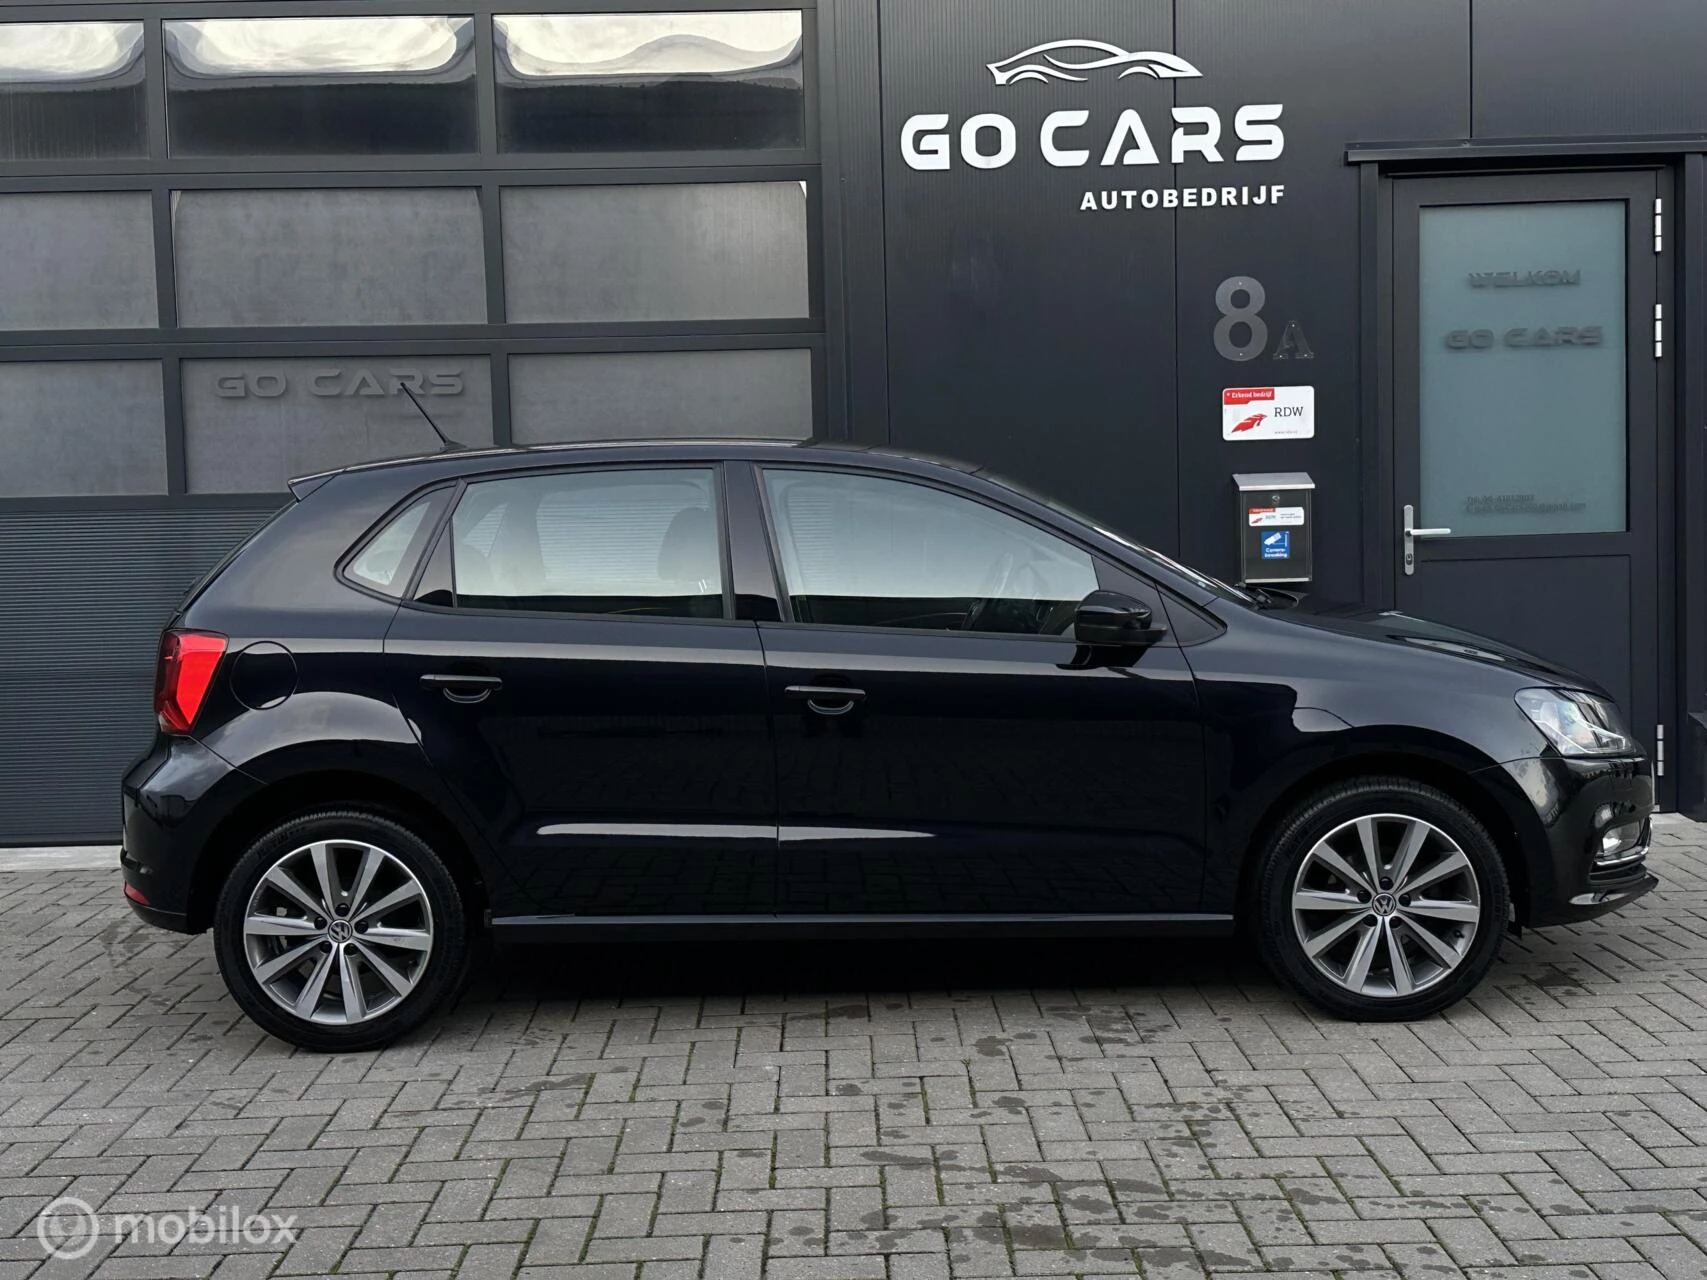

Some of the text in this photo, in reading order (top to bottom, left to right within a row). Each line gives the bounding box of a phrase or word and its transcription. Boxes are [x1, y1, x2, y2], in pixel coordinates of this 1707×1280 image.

[901, 103, 1284, 171] GO CARS
[1080, 185, 1285, 210] AUTOBEDRIJF
[1468, 269, 1581, 288] WELKOM
[1446, 325, 1602, 350] GO CARS
[214, 368, 464, 398] GO CARS
[1274, 406, 1303, 418] RDW
